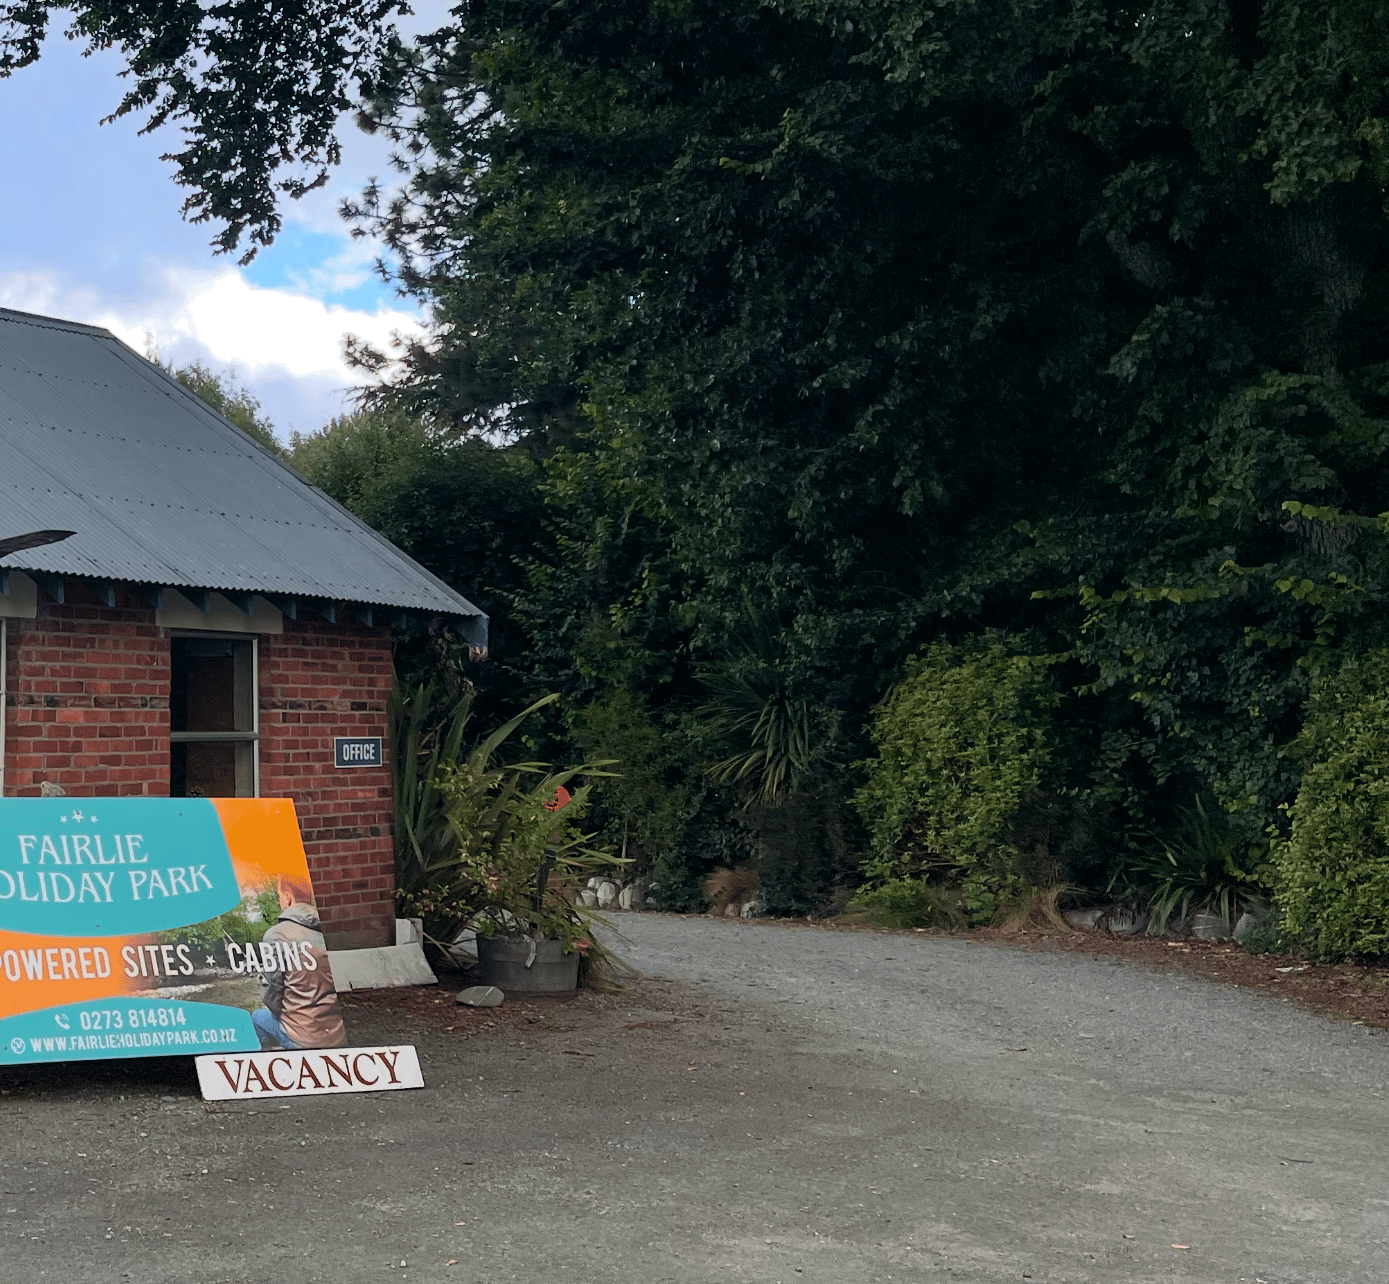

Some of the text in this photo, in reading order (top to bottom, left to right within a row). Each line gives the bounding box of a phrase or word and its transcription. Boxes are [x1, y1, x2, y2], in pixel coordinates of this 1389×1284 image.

[342, 743, 376, 760] OFFICE
[17, 834, 149, 865] FAIRLIE
[128, 864, 214, 901] PARK
[121, 943, 195, 978] SITES
[227, 940, 319, 974] CABINS
[79, 1007, 187, 1031] 0273 814814
[29, 1028, 238, 1053] WWW.FAIRLIEHOLIDAYPARK.CO.NZ
[214, 1051, 401, 1094] VACANCY
